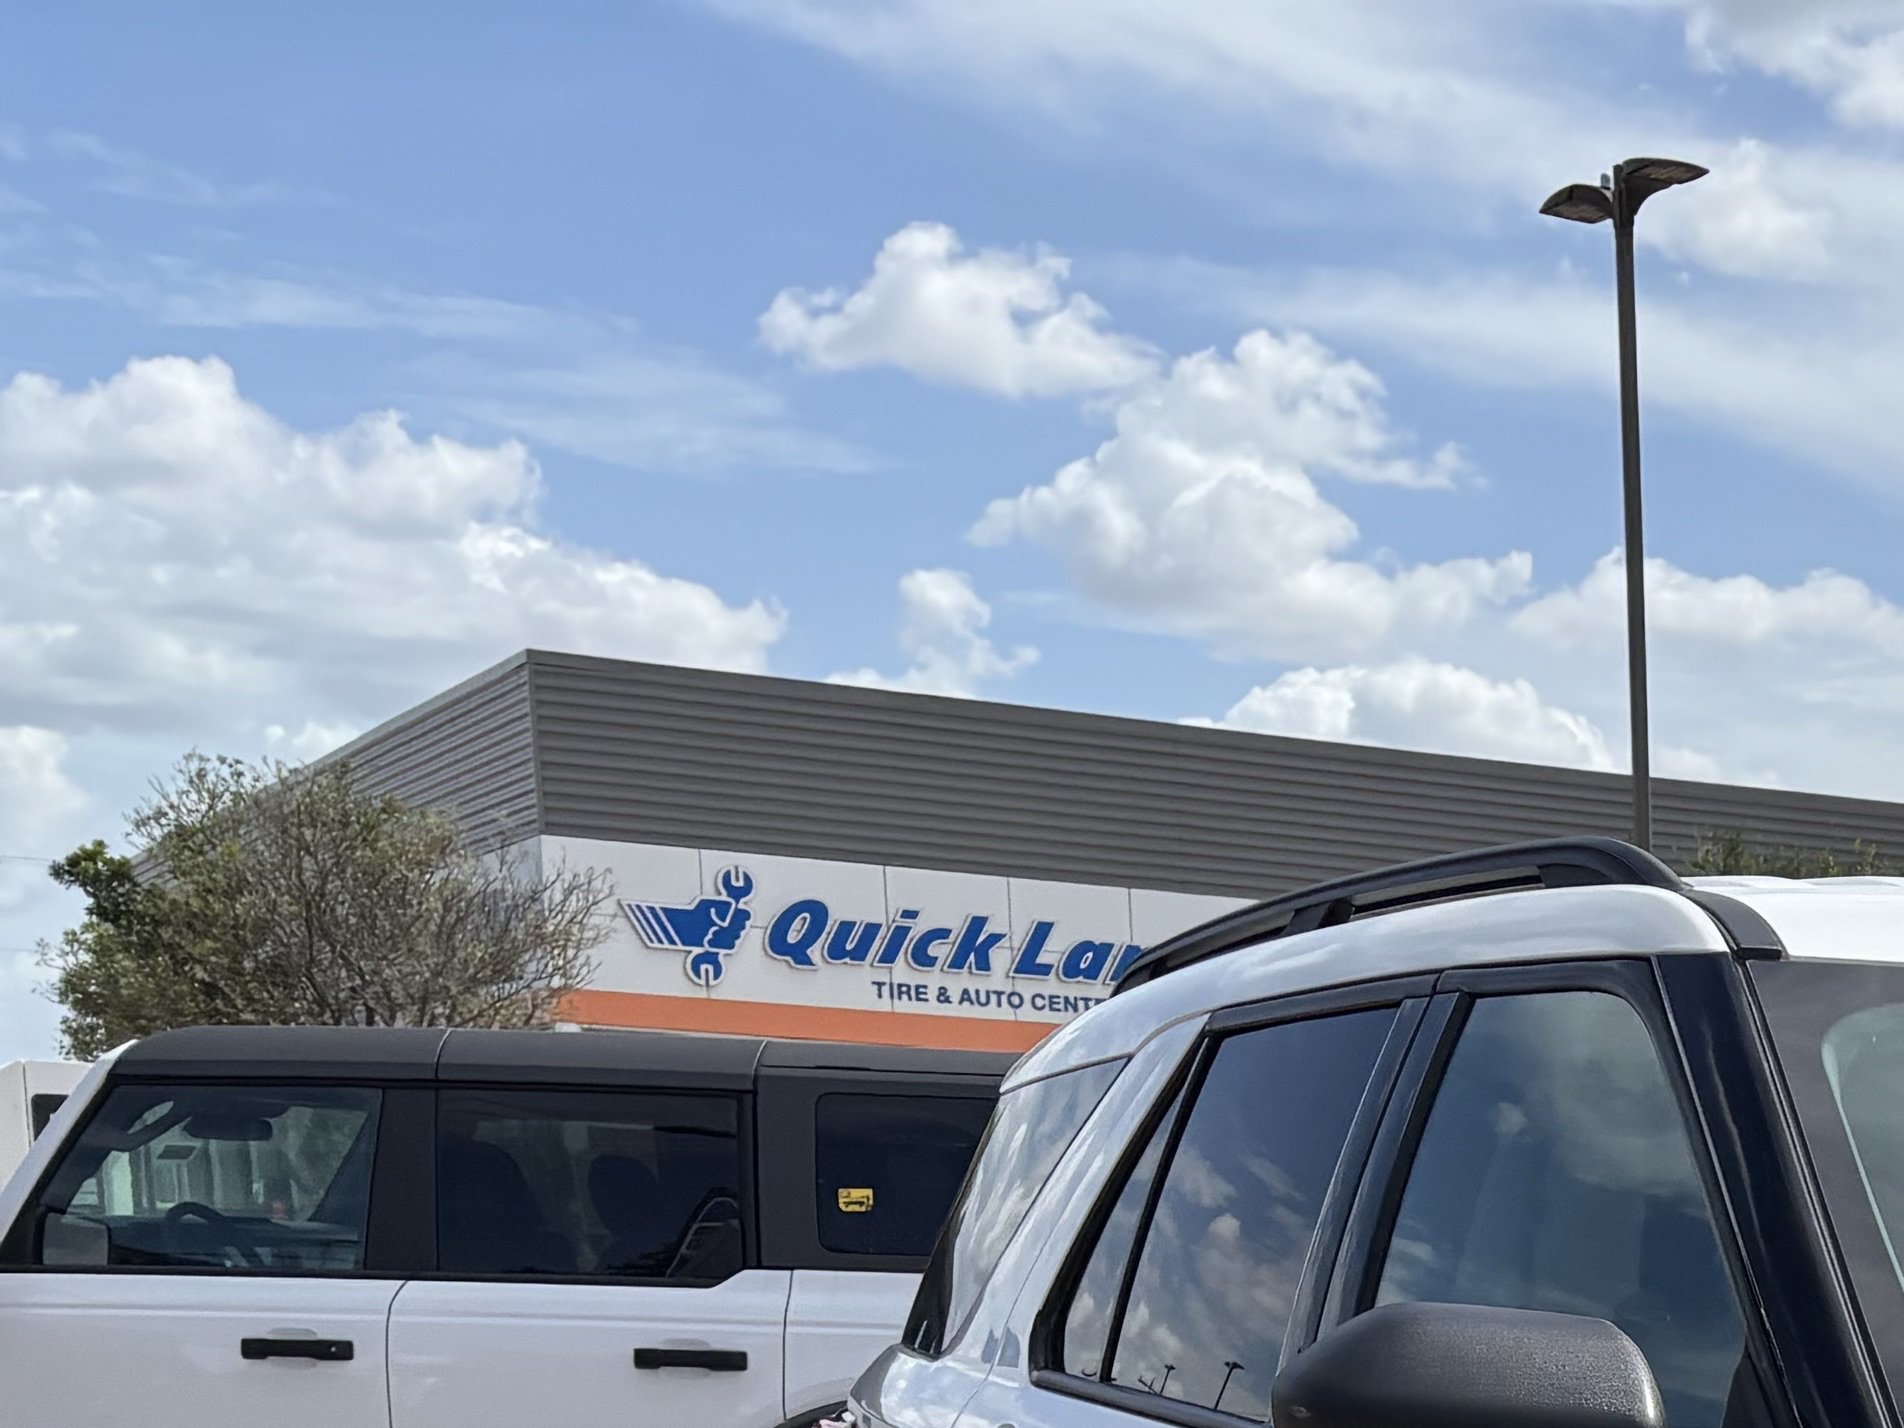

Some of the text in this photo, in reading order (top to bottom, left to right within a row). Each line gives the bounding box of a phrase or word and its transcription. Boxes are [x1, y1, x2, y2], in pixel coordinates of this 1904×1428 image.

[766, 897, 1010, 972] Quick
[872, 981, 929, 1002] TIRE
[936, 986, 953, 1005] &
[958, 987, 1025, 1009] AUTO
